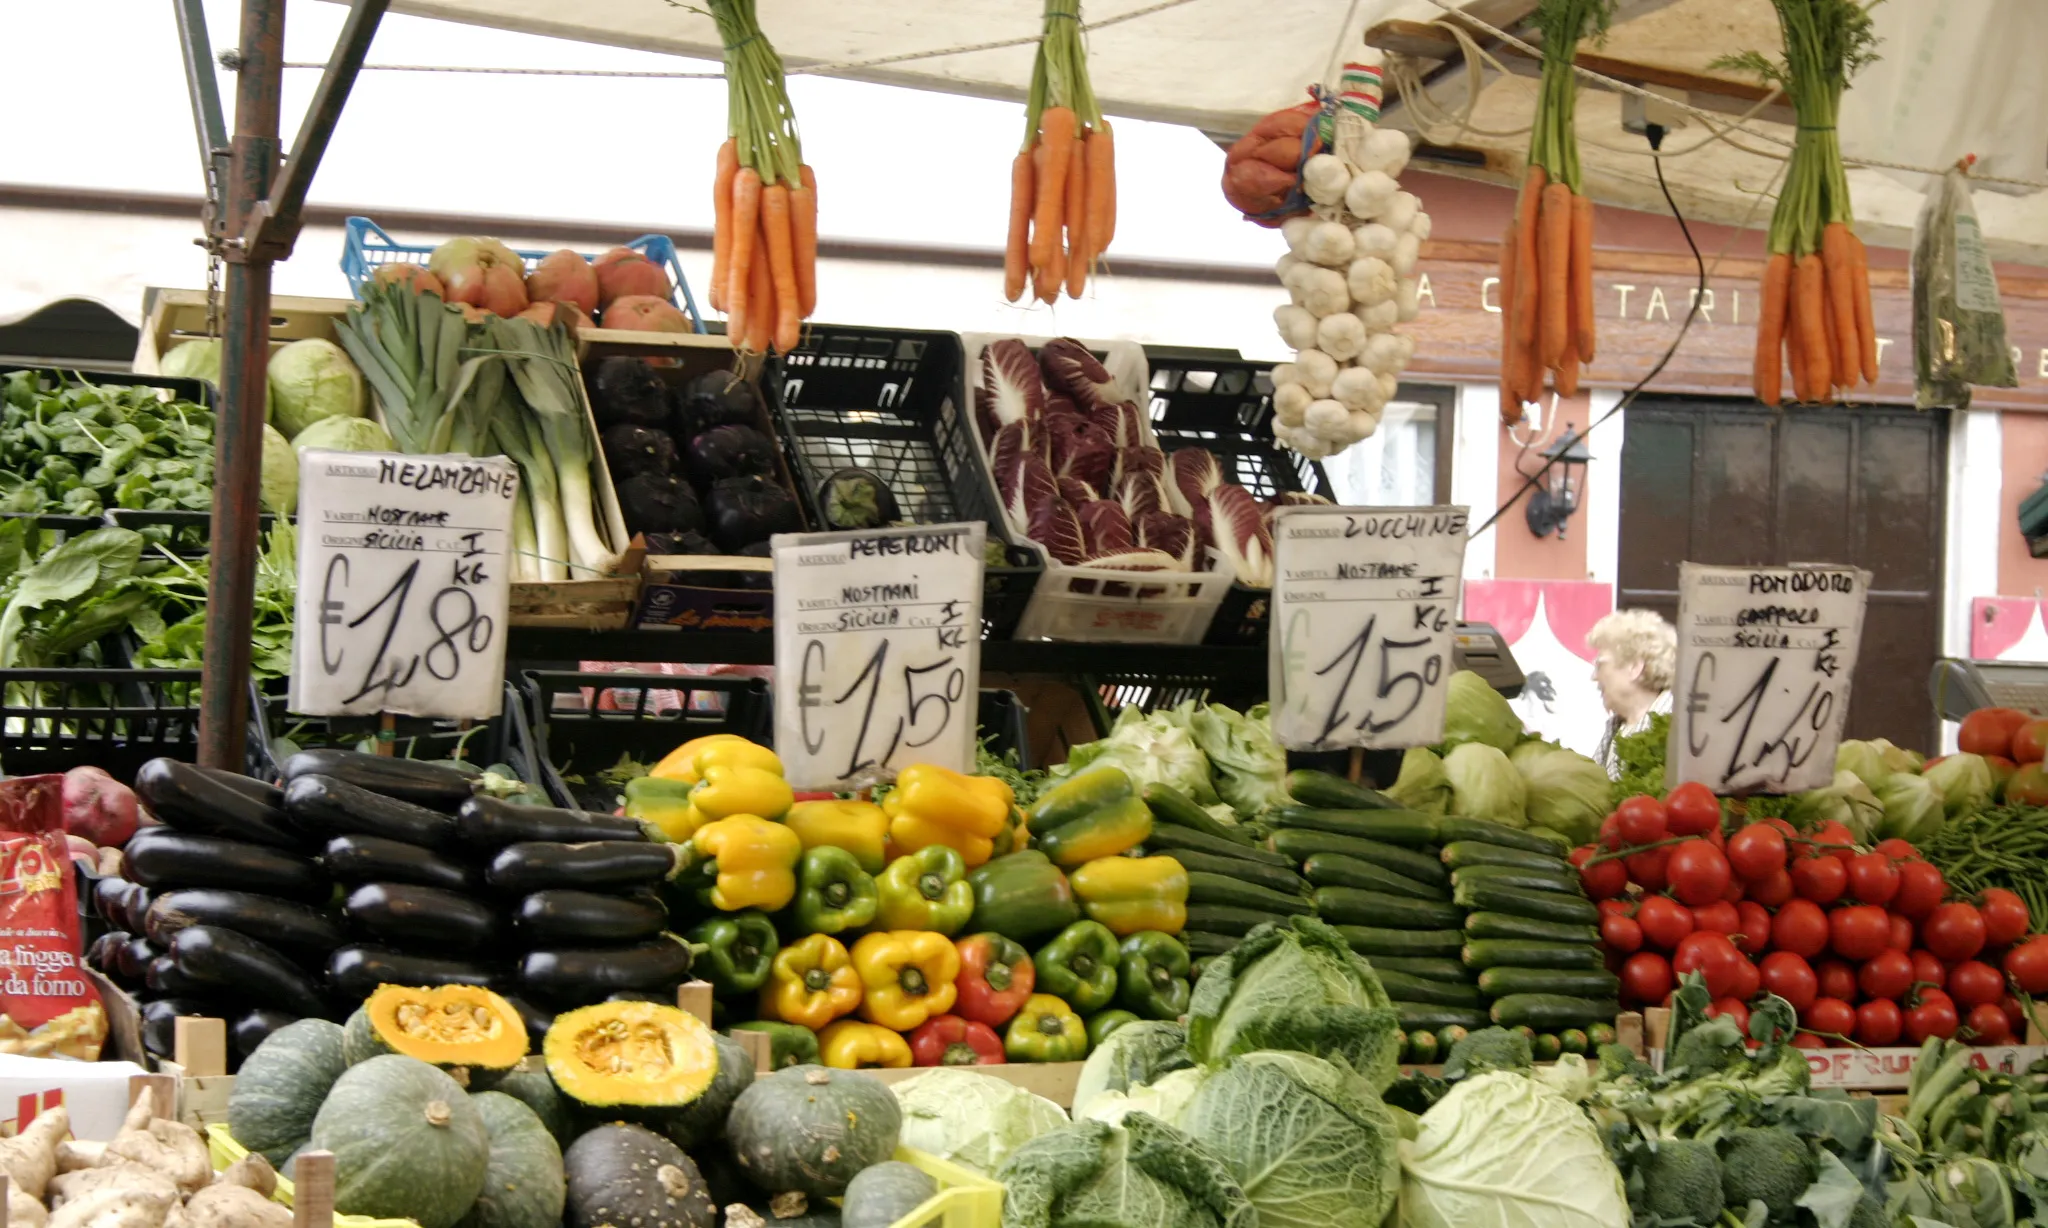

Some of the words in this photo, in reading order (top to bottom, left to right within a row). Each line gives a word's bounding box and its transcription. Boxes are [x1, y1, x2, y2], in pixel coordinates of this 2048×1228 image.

[1344, 515, 1467, 539] ZUCCHINE
[851, 533, 960, 559] PEPERONI
[454, 560, 488, 585] KG
[1750, 572, 1852, 593] POMODORO
[1413, 604, 1449, 632] KG
